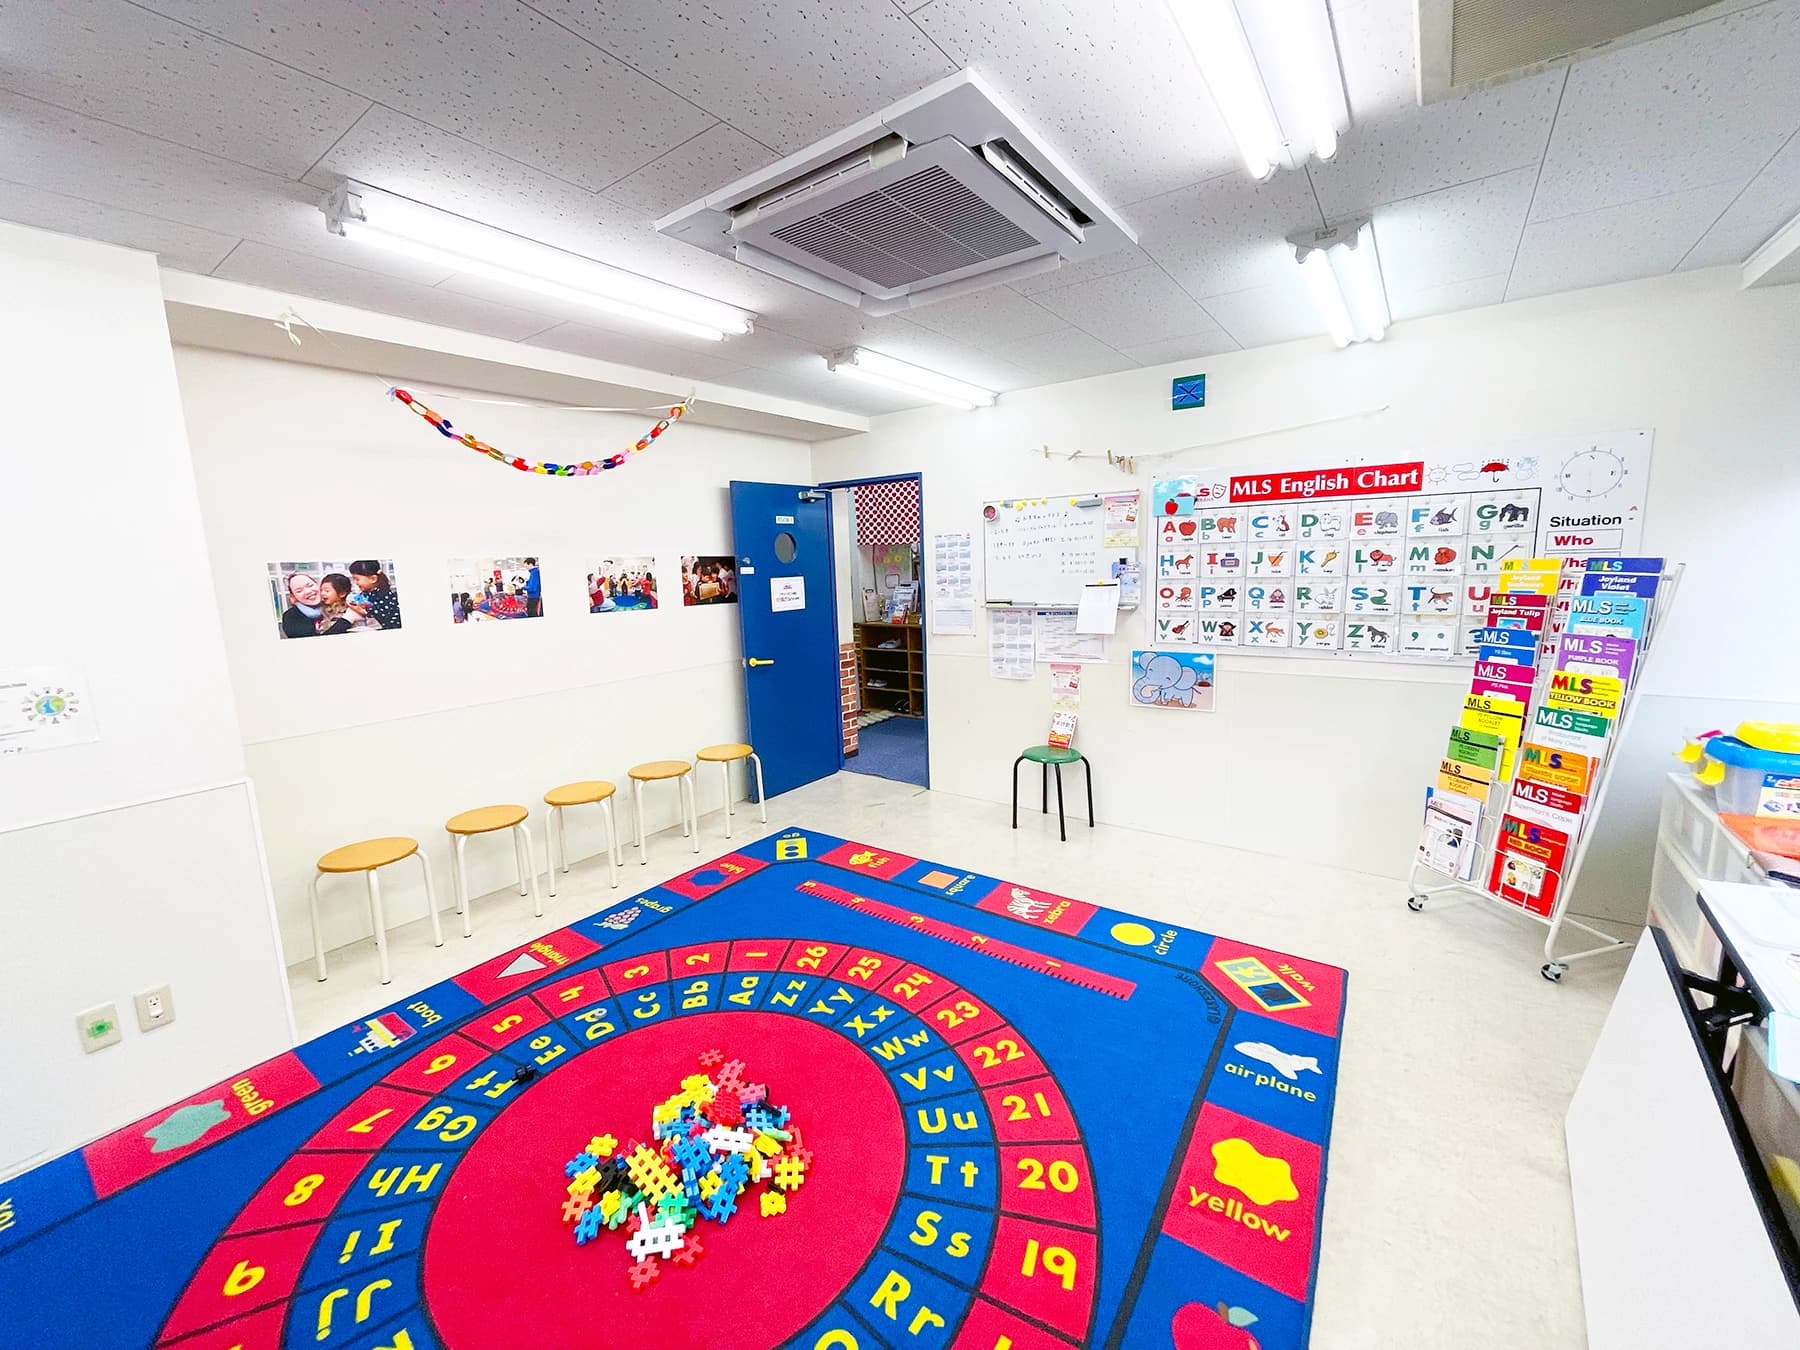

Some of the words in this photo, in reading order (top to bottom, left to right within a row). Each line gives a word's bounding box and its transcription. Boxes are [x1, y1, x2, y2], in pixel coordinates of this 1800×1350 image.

[1231, 479, 1272, 499] MLS
[1280, 472, 1349, 498] English
[1357, 467, 1420, 489] Chart
[1354, 512, 1374, 526] E
[1411, 508, 1430, 523] F
[1476, 504, 1498, 519] G
[1163, 521, 1176, 533] A
[1201, 518, 1216, 530] B
[1251, 516, 1269, 529] C
[1301, 514, 1319, 527] D
[1414, 524, 1424, 532] f
[1480, 520, 1490, 531] g
[1549, 514, 1622, 528] Situation
[1202, 532, 1210, 540] b
[1302, 528, 1311, 538] d
[1554, 535, 1594, 546] Who
[1251, 551, 1263, 565] J
[1299, 550, 1316, 563] K
[1355, 550, 1368, 563] L
[1409, 547, 1429, 561] M
[1471, 545, 1494, 560] N
[1160, 555, 1174, 567] H
[1301, 564, 1309, 574] k
[1410, 564, 1426, 572] m
[1476, 562, 1487, 571] n
[1590, 560, 1623, 571] MLS
[1162, 568, 1169, 576] h
[1598, 575, 1637, 584] Joyland
[1160, 587, 1174, 599] O
[1201, 587, 1216, 599] P
[1248, 587, 1265, 599] Q
[1296, 587, 1312, 600] R
[1350, 587, 1369, 600] S
[1407, 587, 1427, 601] T
[1468, 586, 1491, 601] U
[1601, 583, 1631, 591] Violet
[1251, 600, 1260, 609] q
[1492, 595, 1517, 606] MLS
[1572, 599, 1614, 615] MLS
[1490, 608, 1518, 616] Joyland
[1158, 620, 1170, 631] V
[1201, 620, 1218, 632] W
[1248, 620, 1264, 633] X
[1296, 622, 1313, 635] Y
[1347, 624, 1365, 638] Z
[1299, 636, 1309, 645] y
[1483, 630, 1510, 644] MLS
[1564, 638, 1603, 654] MLS
[1595, 657, 1619, 665] BOOK
[1478, 663, 1507, 680] MLS
[1551, 674, 1593, 695] MLS
[1467, 697, 1491, 710] MLS
[1550, 692, 1583, 704] YELLOW
[1583, 698, 1616, 709] BOOK
[1538, 710, 1573, 729] MLS
[1450, 728, 1471, 741] MLS
[1524, 748, 1562, 769] MLS
[1440, 761, 1462, 774] MLS
[1515, 782, 1549, 804] MLS
[1503, 819, 1541, 844] MLS
[720, 863, 745, 874] blue
[867, 854, 891, 870] fish
[943, 872, 976, 896] square
[633, 897, 673, 916] grapes
[1041, 900, 1072, 925] zebra
[910, 915, 925, 924] 3
[971, 935, 989, 945] 2
[1155, 930, 1178, 955] circle
[528, 939, 570, 968] triangle
[685, 952, 710, 966] 2
[796, 946, 828, 970] 26
[623, 965, 650, 979] 3
[847, 956, 882, 981] 25
[893, 972, 933, 1000] 24
[1276, 963, 1316, 993] walk
[559, 985, 584, 1002] 4
[682, 980, 709, 1010] Bb
[728, 976, 759, 1006] Aa
[770, 979, 807, 1007] Zz
[633, 991, 661, 1019] Cc
[808, 986, 855, 1015] Yy
[406, 1001, 443, 1028] boat
[843, 1005, 895, 1038] Xx
[936, 1000, 980, 1029] 23
[491, 1015, 523, 1033] 5
[574, 1007, 615, 1041] Dd
[529, 1035, 567, 1066] Ee
[871, 1029, 930, 1061] Ww
[973, 1039, 1025, 1069] 22
[423, 1054, 457, 1075] 6
[465, 1070, 519, 1100] Ff
[900, 1065, 954, 1091] Vv
[1224, 1062, 1317, 1102] airplane
[231, 1077, 275, 1116] green
[1001, 1092, 1051, 1121] 21
[347, 1108, 393, 1133] 7
[414, 1105, 477, 1142] Gg
[917, 1107, 978, 1134] Uu
[926, 1155, 979, 1188] Tt
[1017, 1157, 1079, 1193] 20
[368, 1163, 443, 1197] Hh
[283, 1173, 325, 1206] 8
[1188, 1184, 1292, 1243] yellow
[339, 1219, 403, 1264] Ii
[909, 1210, 972, 1258] Ss
[1021, 1238, 1077, 1291] 19
[223, 1260, 265, 1296] 9
[316, 1278, 393, 1341] Jj
[869, 1269, 945, 1336] Rr
